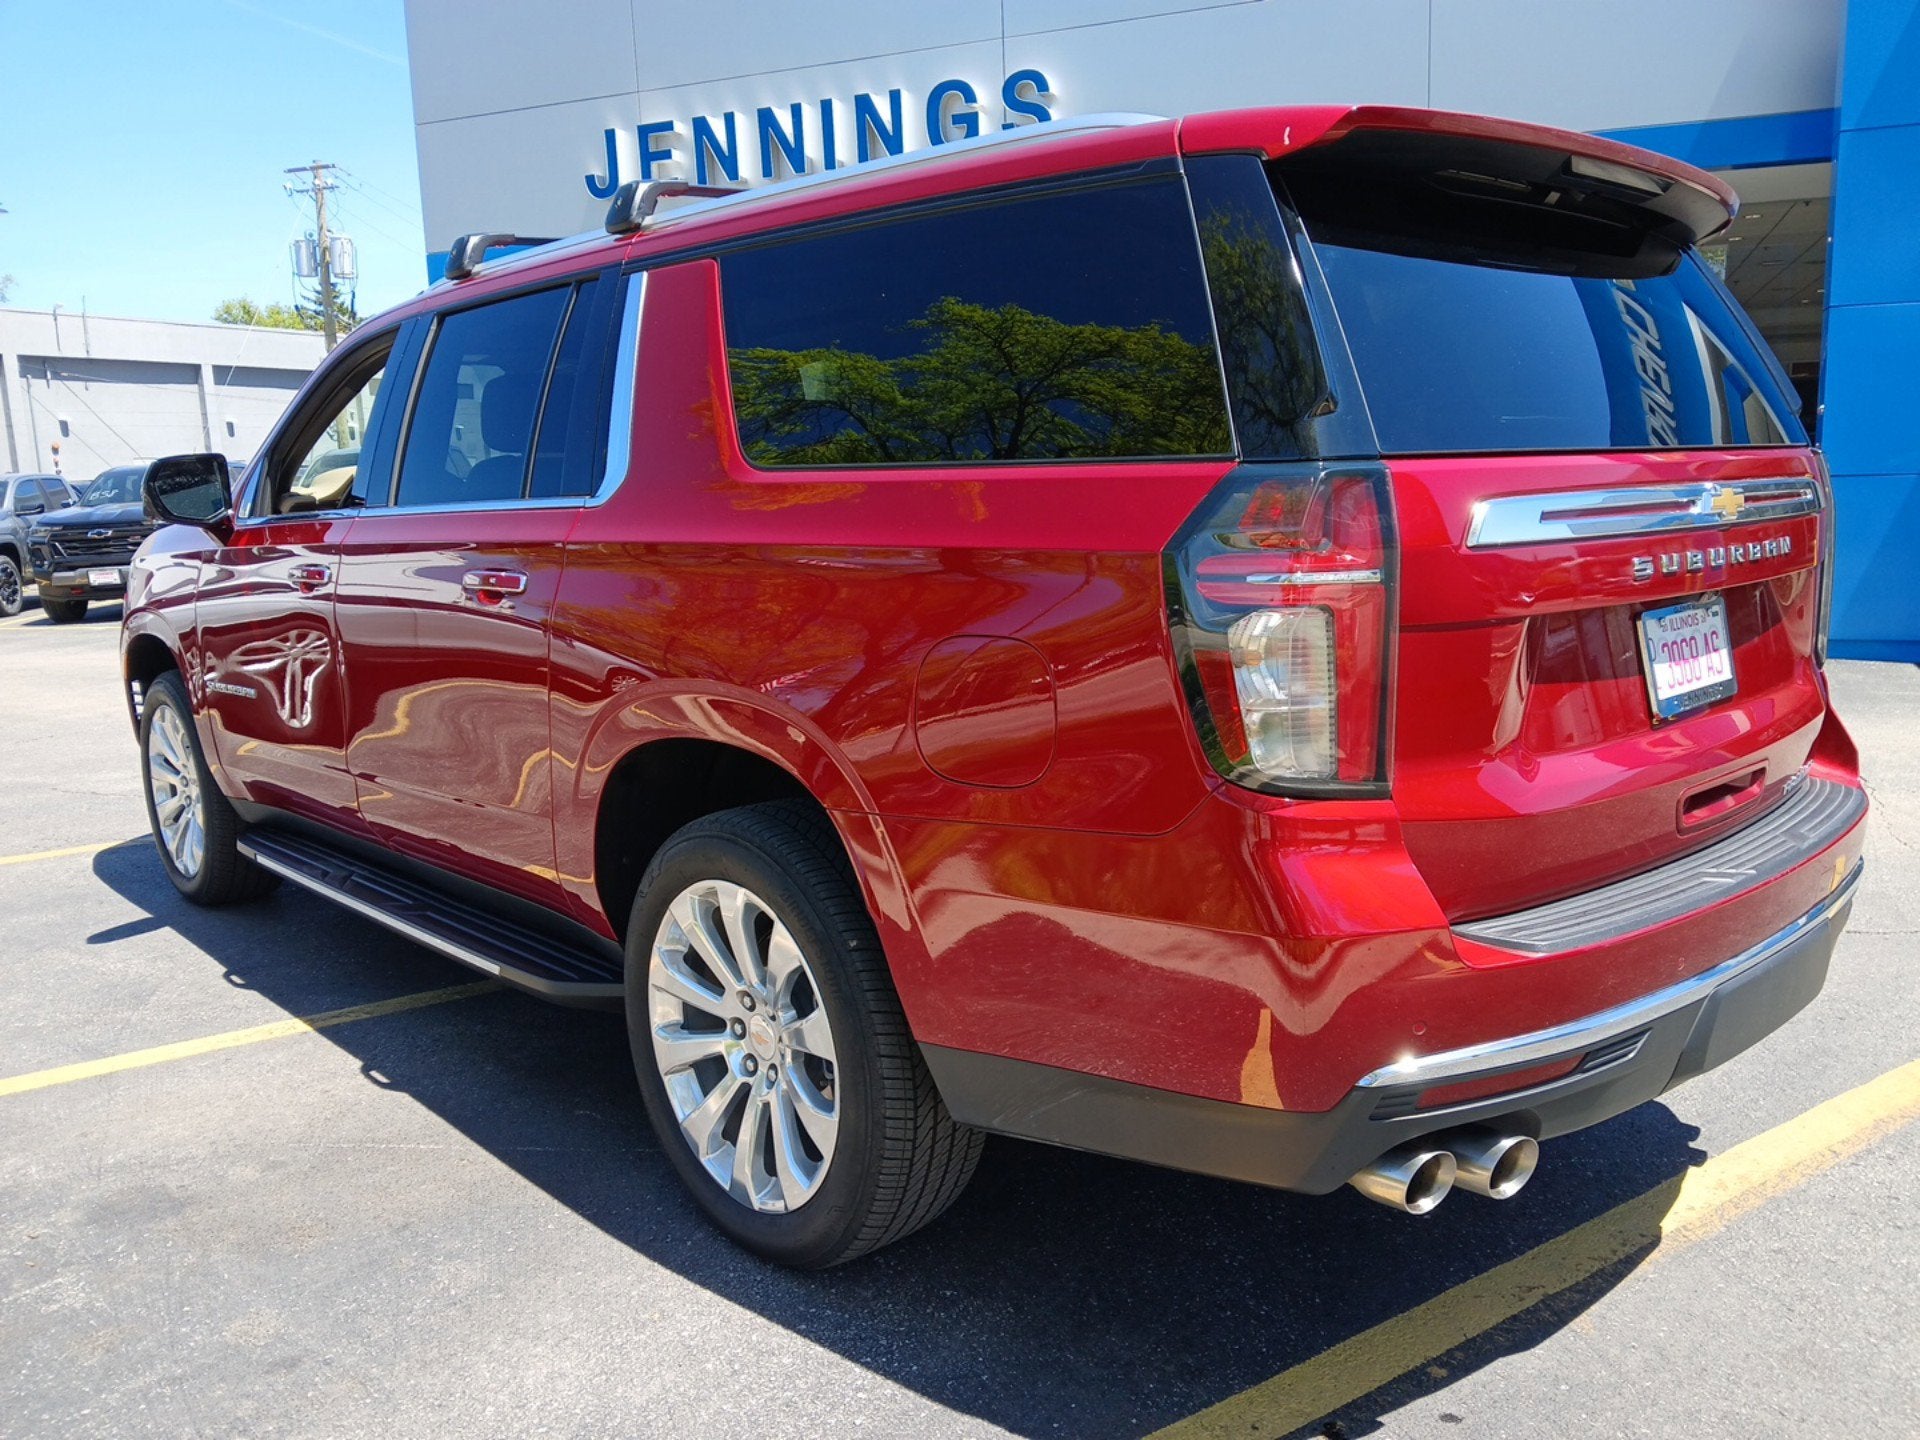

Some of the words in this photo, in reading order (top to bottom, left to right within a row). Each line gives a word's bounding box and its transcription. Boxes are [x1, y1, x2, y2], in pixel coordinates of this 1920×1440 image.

[584, 68, 1053, 200] JENNINGS
[1631, 535, 1792, 583] SUBURBAN
[1669, 612, 1700, 632] ILLINOIS
